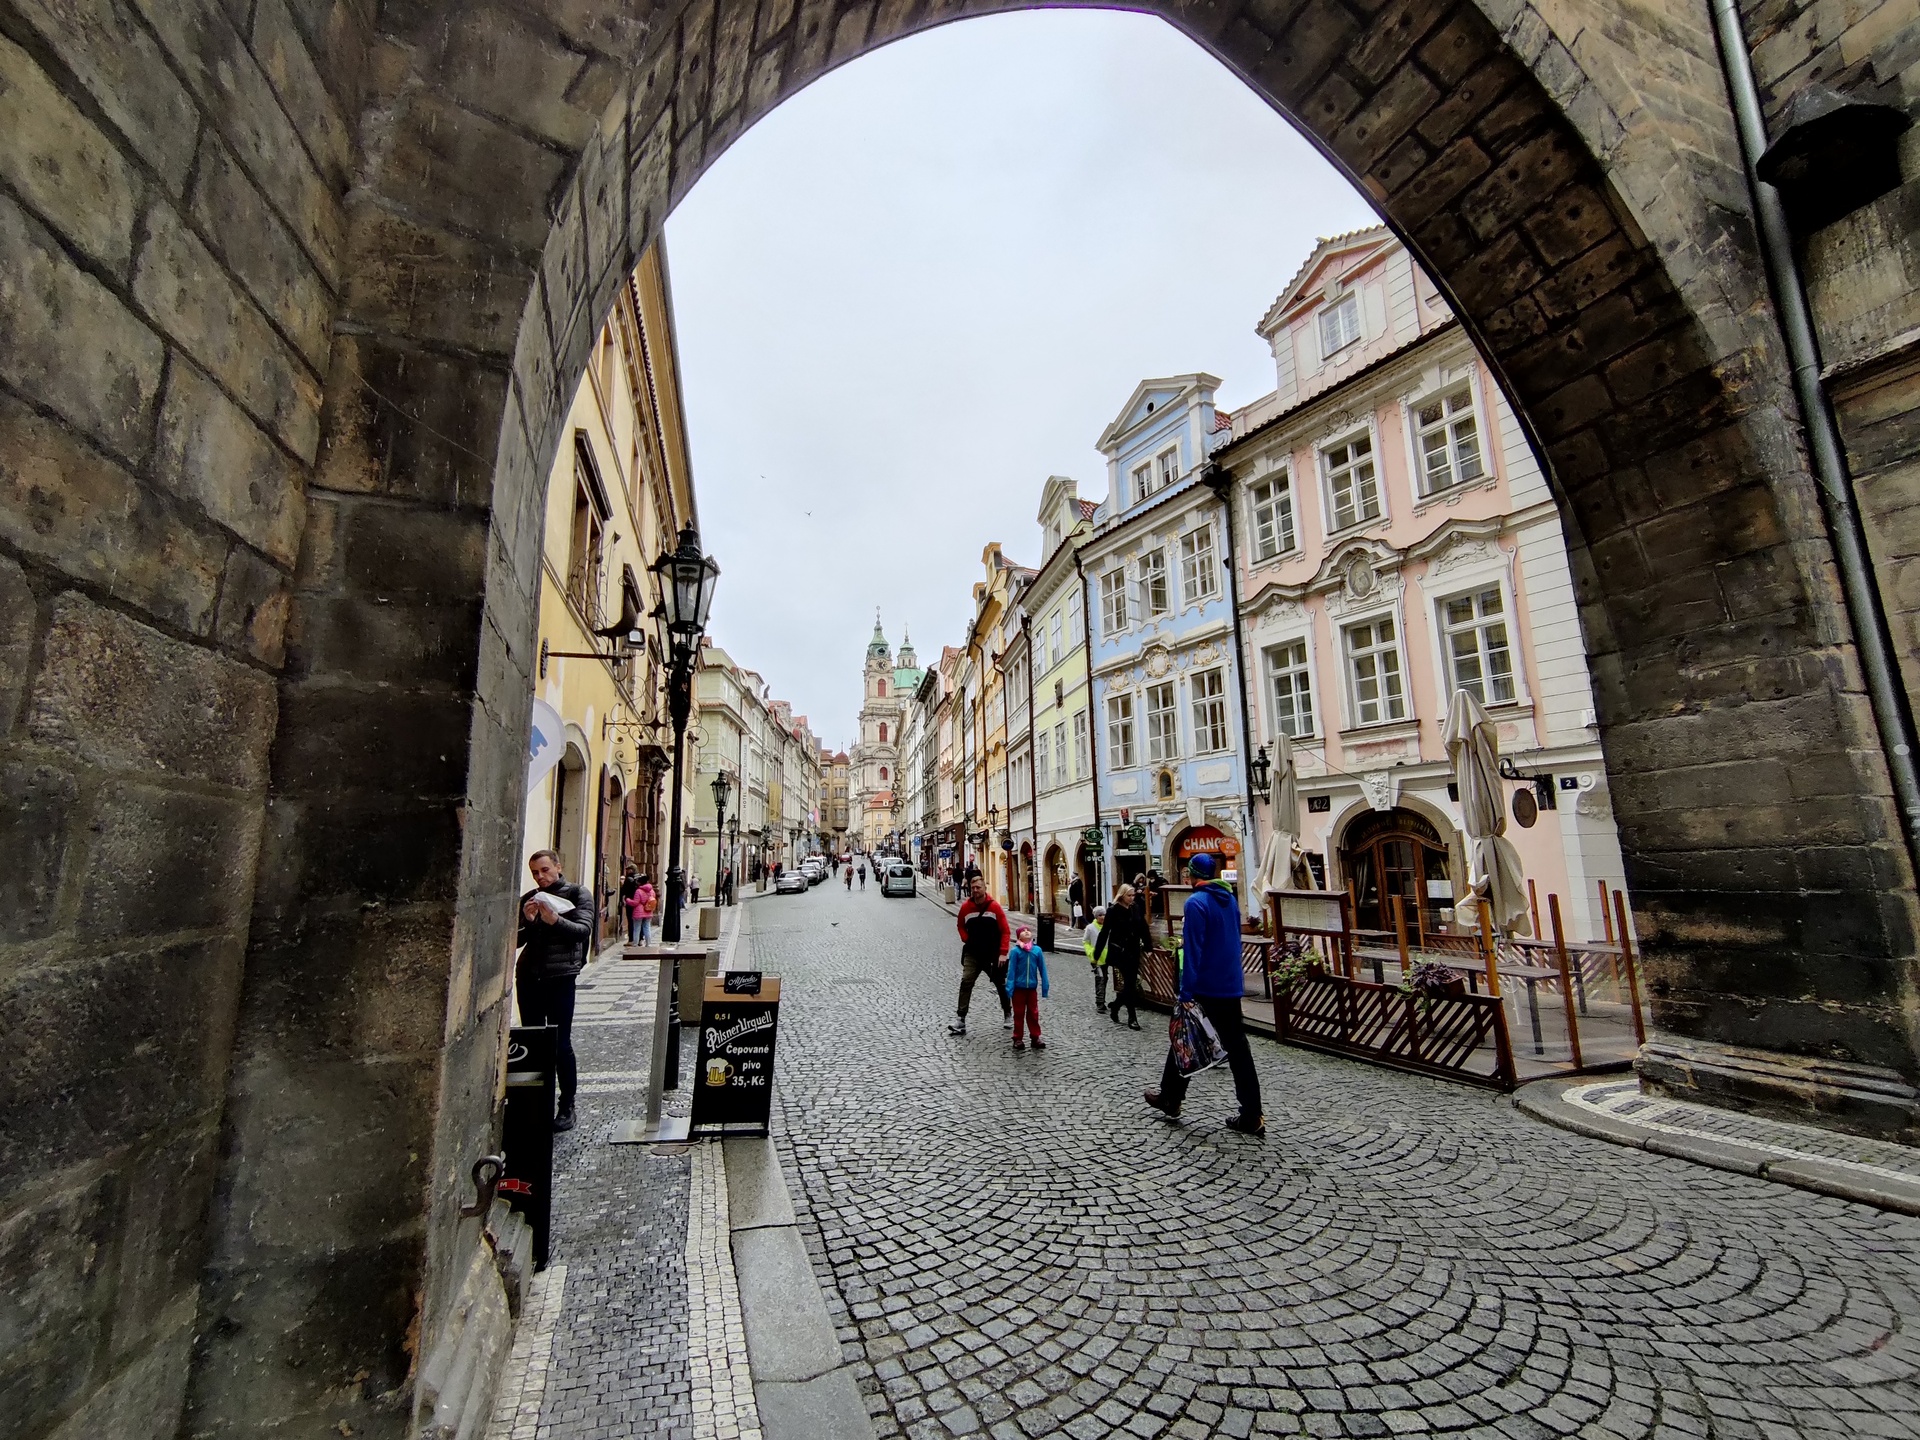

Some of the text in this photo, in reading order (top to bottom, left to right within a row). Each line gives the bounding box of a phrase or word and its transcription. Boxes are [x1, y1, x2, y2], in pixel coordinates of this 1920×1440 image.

[1565, 779, 1572, 787] 2
[706, 1010, 772, 1053] Pilsner Urquell
[726, 1042, 770, 1056] Čepované
[742, 1060, 761, 1072] pivo
